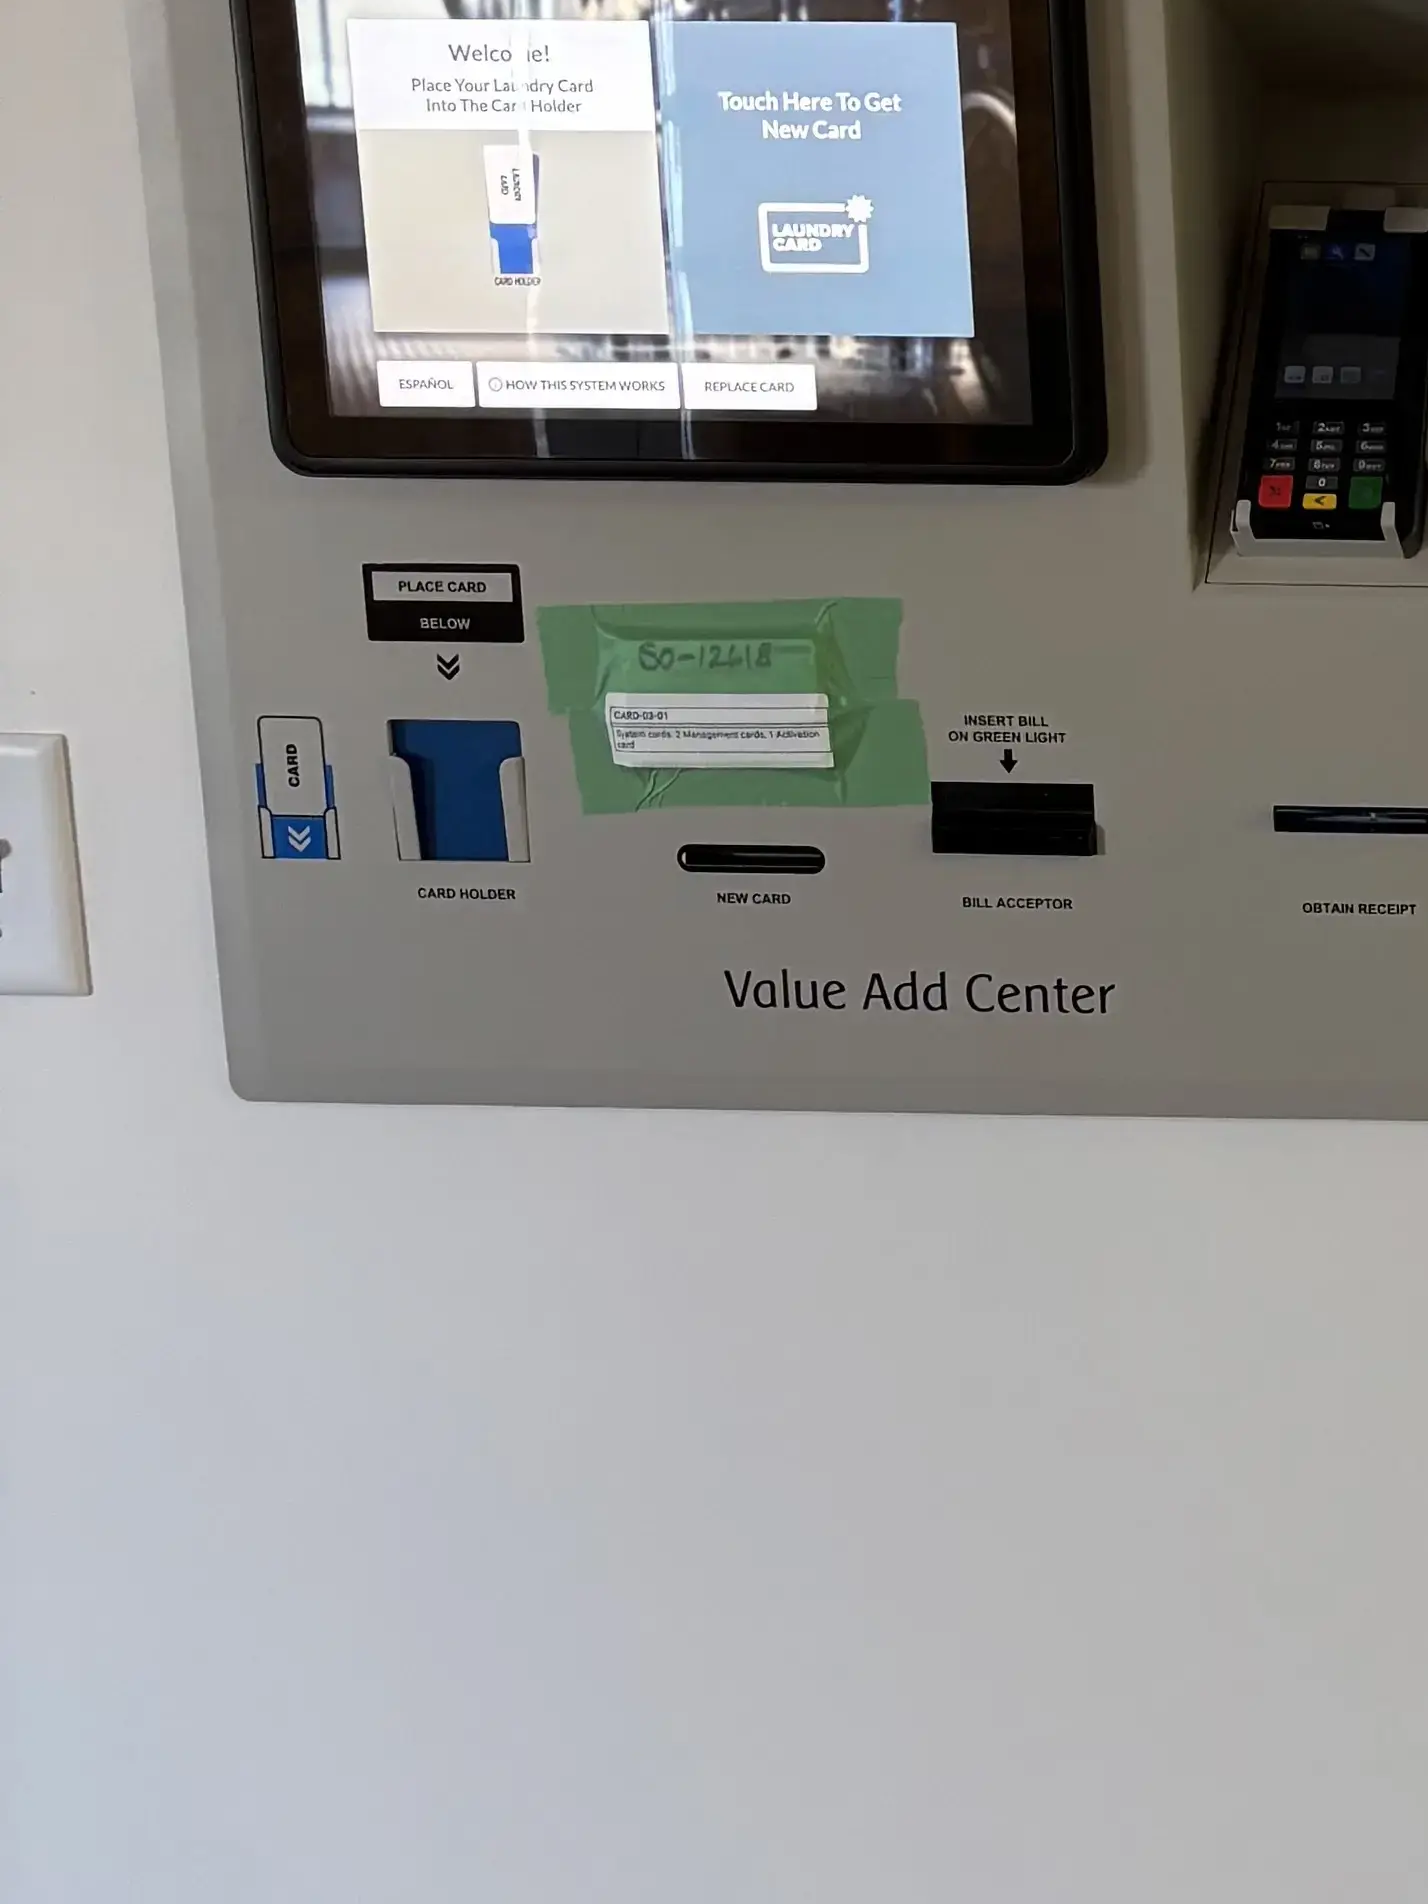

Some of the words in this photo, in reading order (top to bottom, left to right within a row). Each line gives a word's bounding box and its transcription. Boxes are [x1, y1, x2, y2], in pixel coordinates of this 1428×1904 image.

[448, 45, 550, 62] Welcoe!
[411, 78, 452, 92] Place
[455, 79, 490, 92] Your
[558, 79, 593, 92] Card
[427, 99, 456, 112] Into
[460, 99, 488, 112] The
[531, 100, 582, 113] Holder
[717, 91, 778, 111] Touch
[783, 92, 833, 111] Here
[835, 92, 861, 111] To
[864, 93, 902, 112] Get
[762, 120, 809, 139] New
[812, 120, 861, 139] Card
[772, 224, 855, 238] LAUNDRY
[773, 238, 822, 251] CARD
[399, 377, 454, 390] ESPAÑOL
[506, 379, 537, 391] HOW
[541, 380, 567, 391] THIS
[570, 380, 617, 392] SYSTEM
[619, 380, 666, 392] WORKS
[705, 381, 757, 393] REPLACE
[759, 382, 794, 394] CARD
[398, 580, 444, 592] PLACE
[447, 581, 486, 593] CARD
[420, 617, 471, 630] BELOW
[964, 715, 1014, 726] INSERT
[1018, 716, 1049, 727] BILL
[948, 731, 968, 742] ON
[973, 731, 1021, 743] GREEN
[1025, 732, 1066, 743] LIGHT
[286, 743, 300, 787] CARD
[417, 887, 456, 900] CARD
[460, 887, 516, 901] HOLDER
[716, 892, 749, 904] NEW
[752, 893, 792, 905] CARD
[962, 896, 993, 908] BILL
[996, 897, 1073, 910] ACCEPTOR
[1302, 902, 1354, 914] OBTAIN
[1358, 903, 1417, 915] RECEIPT
[724, 968, 846, 1010] Value
[862, 970, 948, 1011] Add
[965, 973, 1116, 1014] Center
